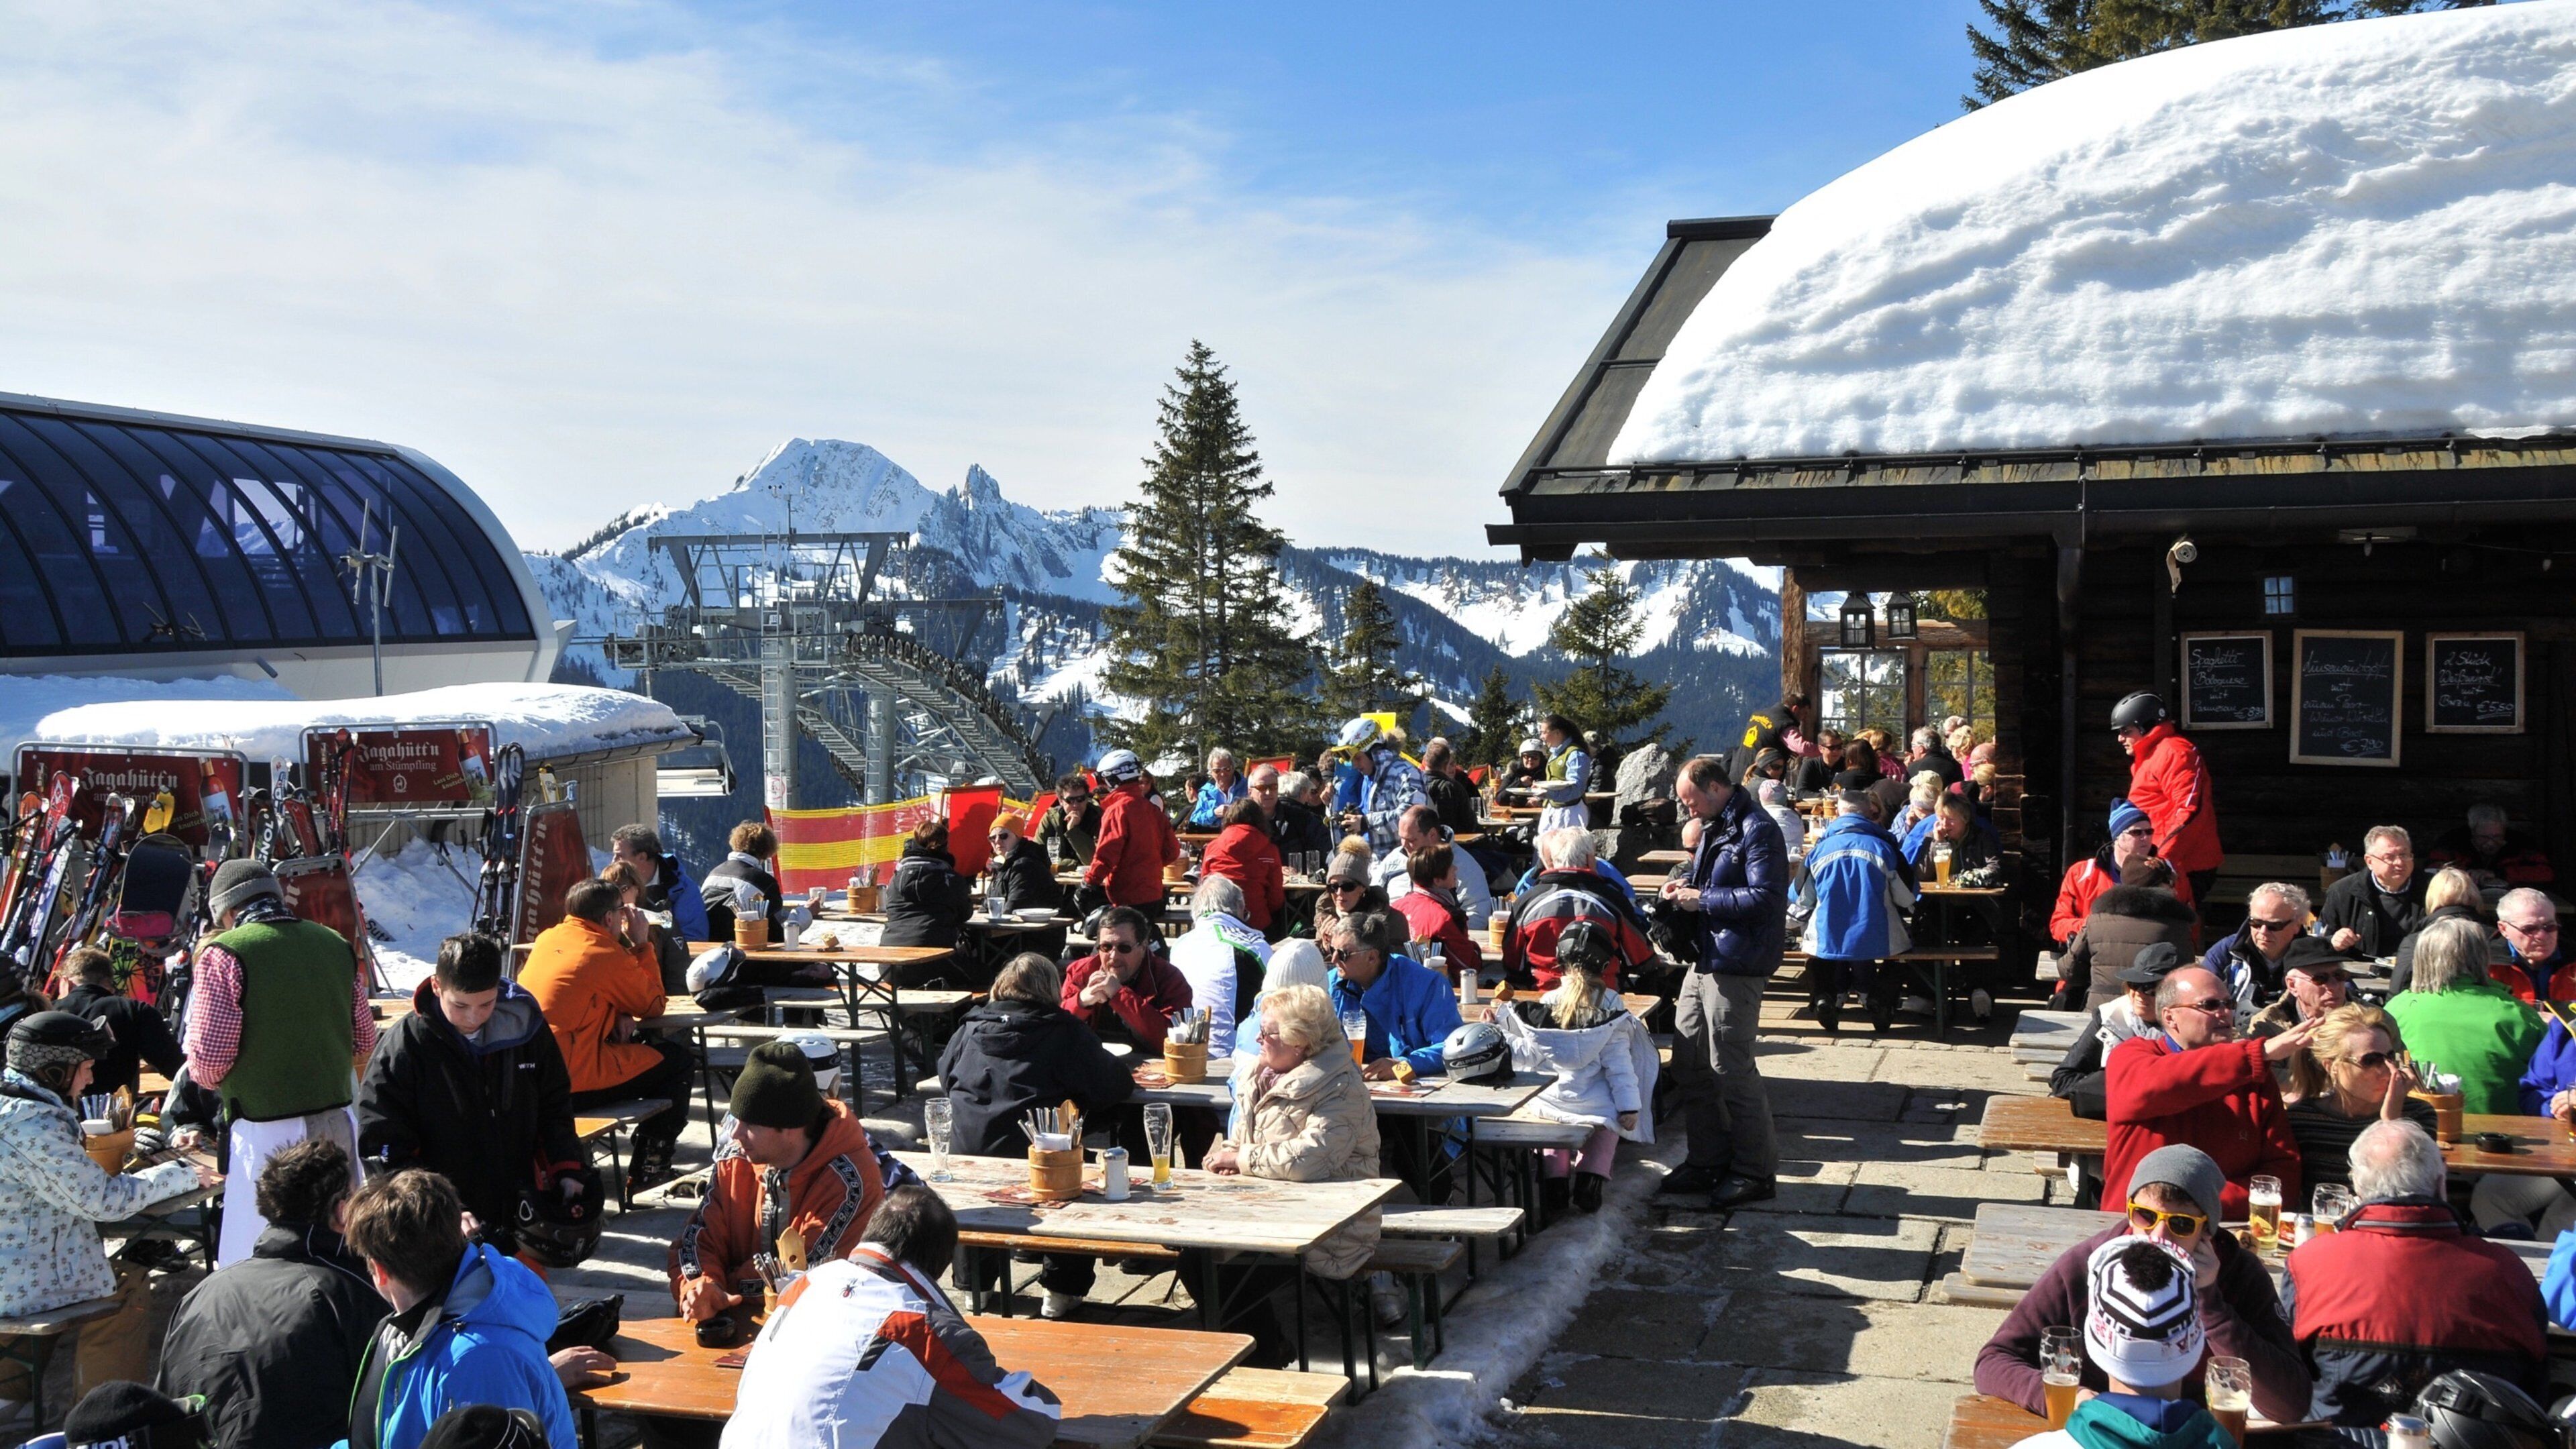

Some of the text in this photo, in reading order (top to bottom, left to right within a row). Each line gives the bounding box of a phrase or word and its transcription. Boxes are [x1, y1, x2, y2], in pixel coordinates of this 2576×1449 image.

[2190, 647, 2245, 672] Spaghetti
[2330, 678, 2353, 691] mit
[2210, 689, 2229, 699] mit
[386, 760, 437, 772] Stümpfling
[1456, 1055, 1487, 1067] ALPINA
